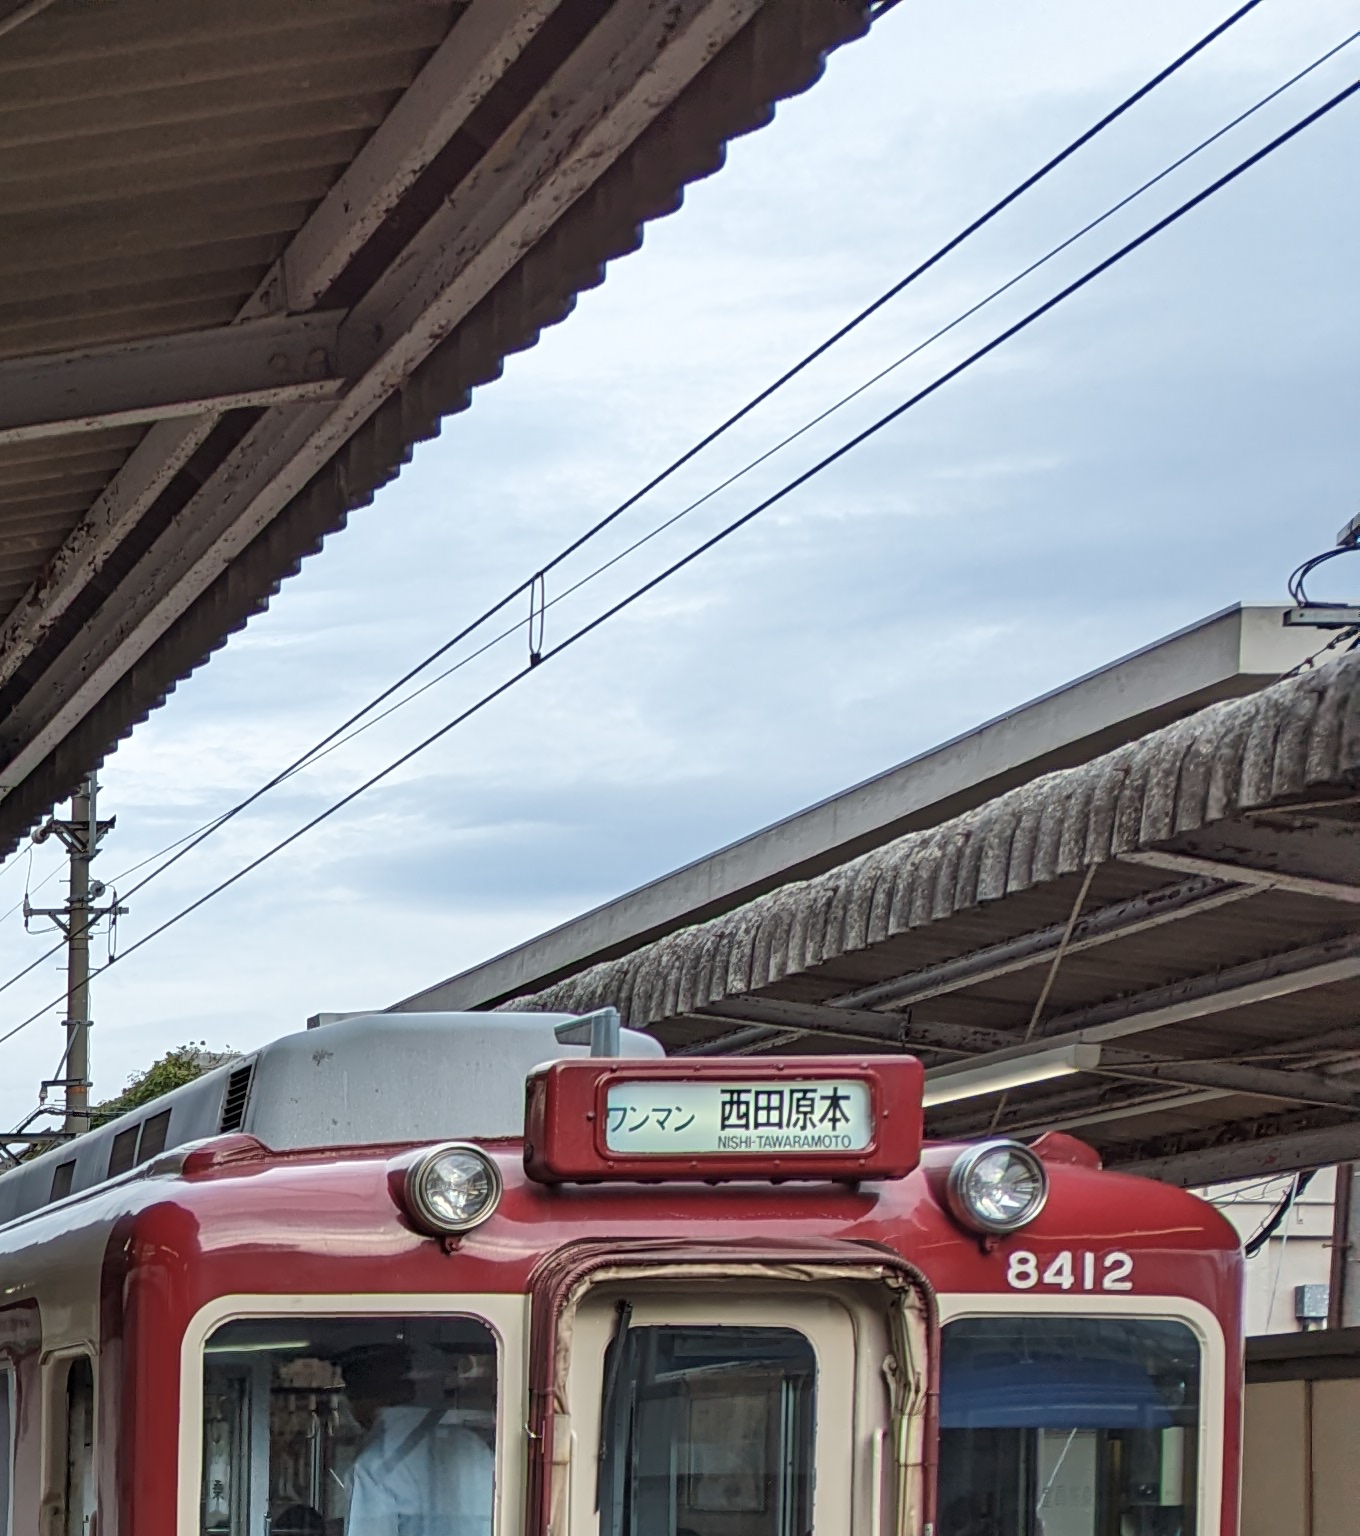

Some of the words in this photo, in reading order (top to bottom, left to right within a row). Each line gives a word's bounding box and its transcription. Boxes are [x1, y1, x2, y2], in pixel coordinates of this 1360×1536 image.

[607, 1106, 696, 1133] ワンマン
[720, 1086, 851, 1132] 西田原本
[717, 1134, 852, 1149] NISHI-TAWARAMOTO
[1007, 1251, 1134, 1291] 8412
